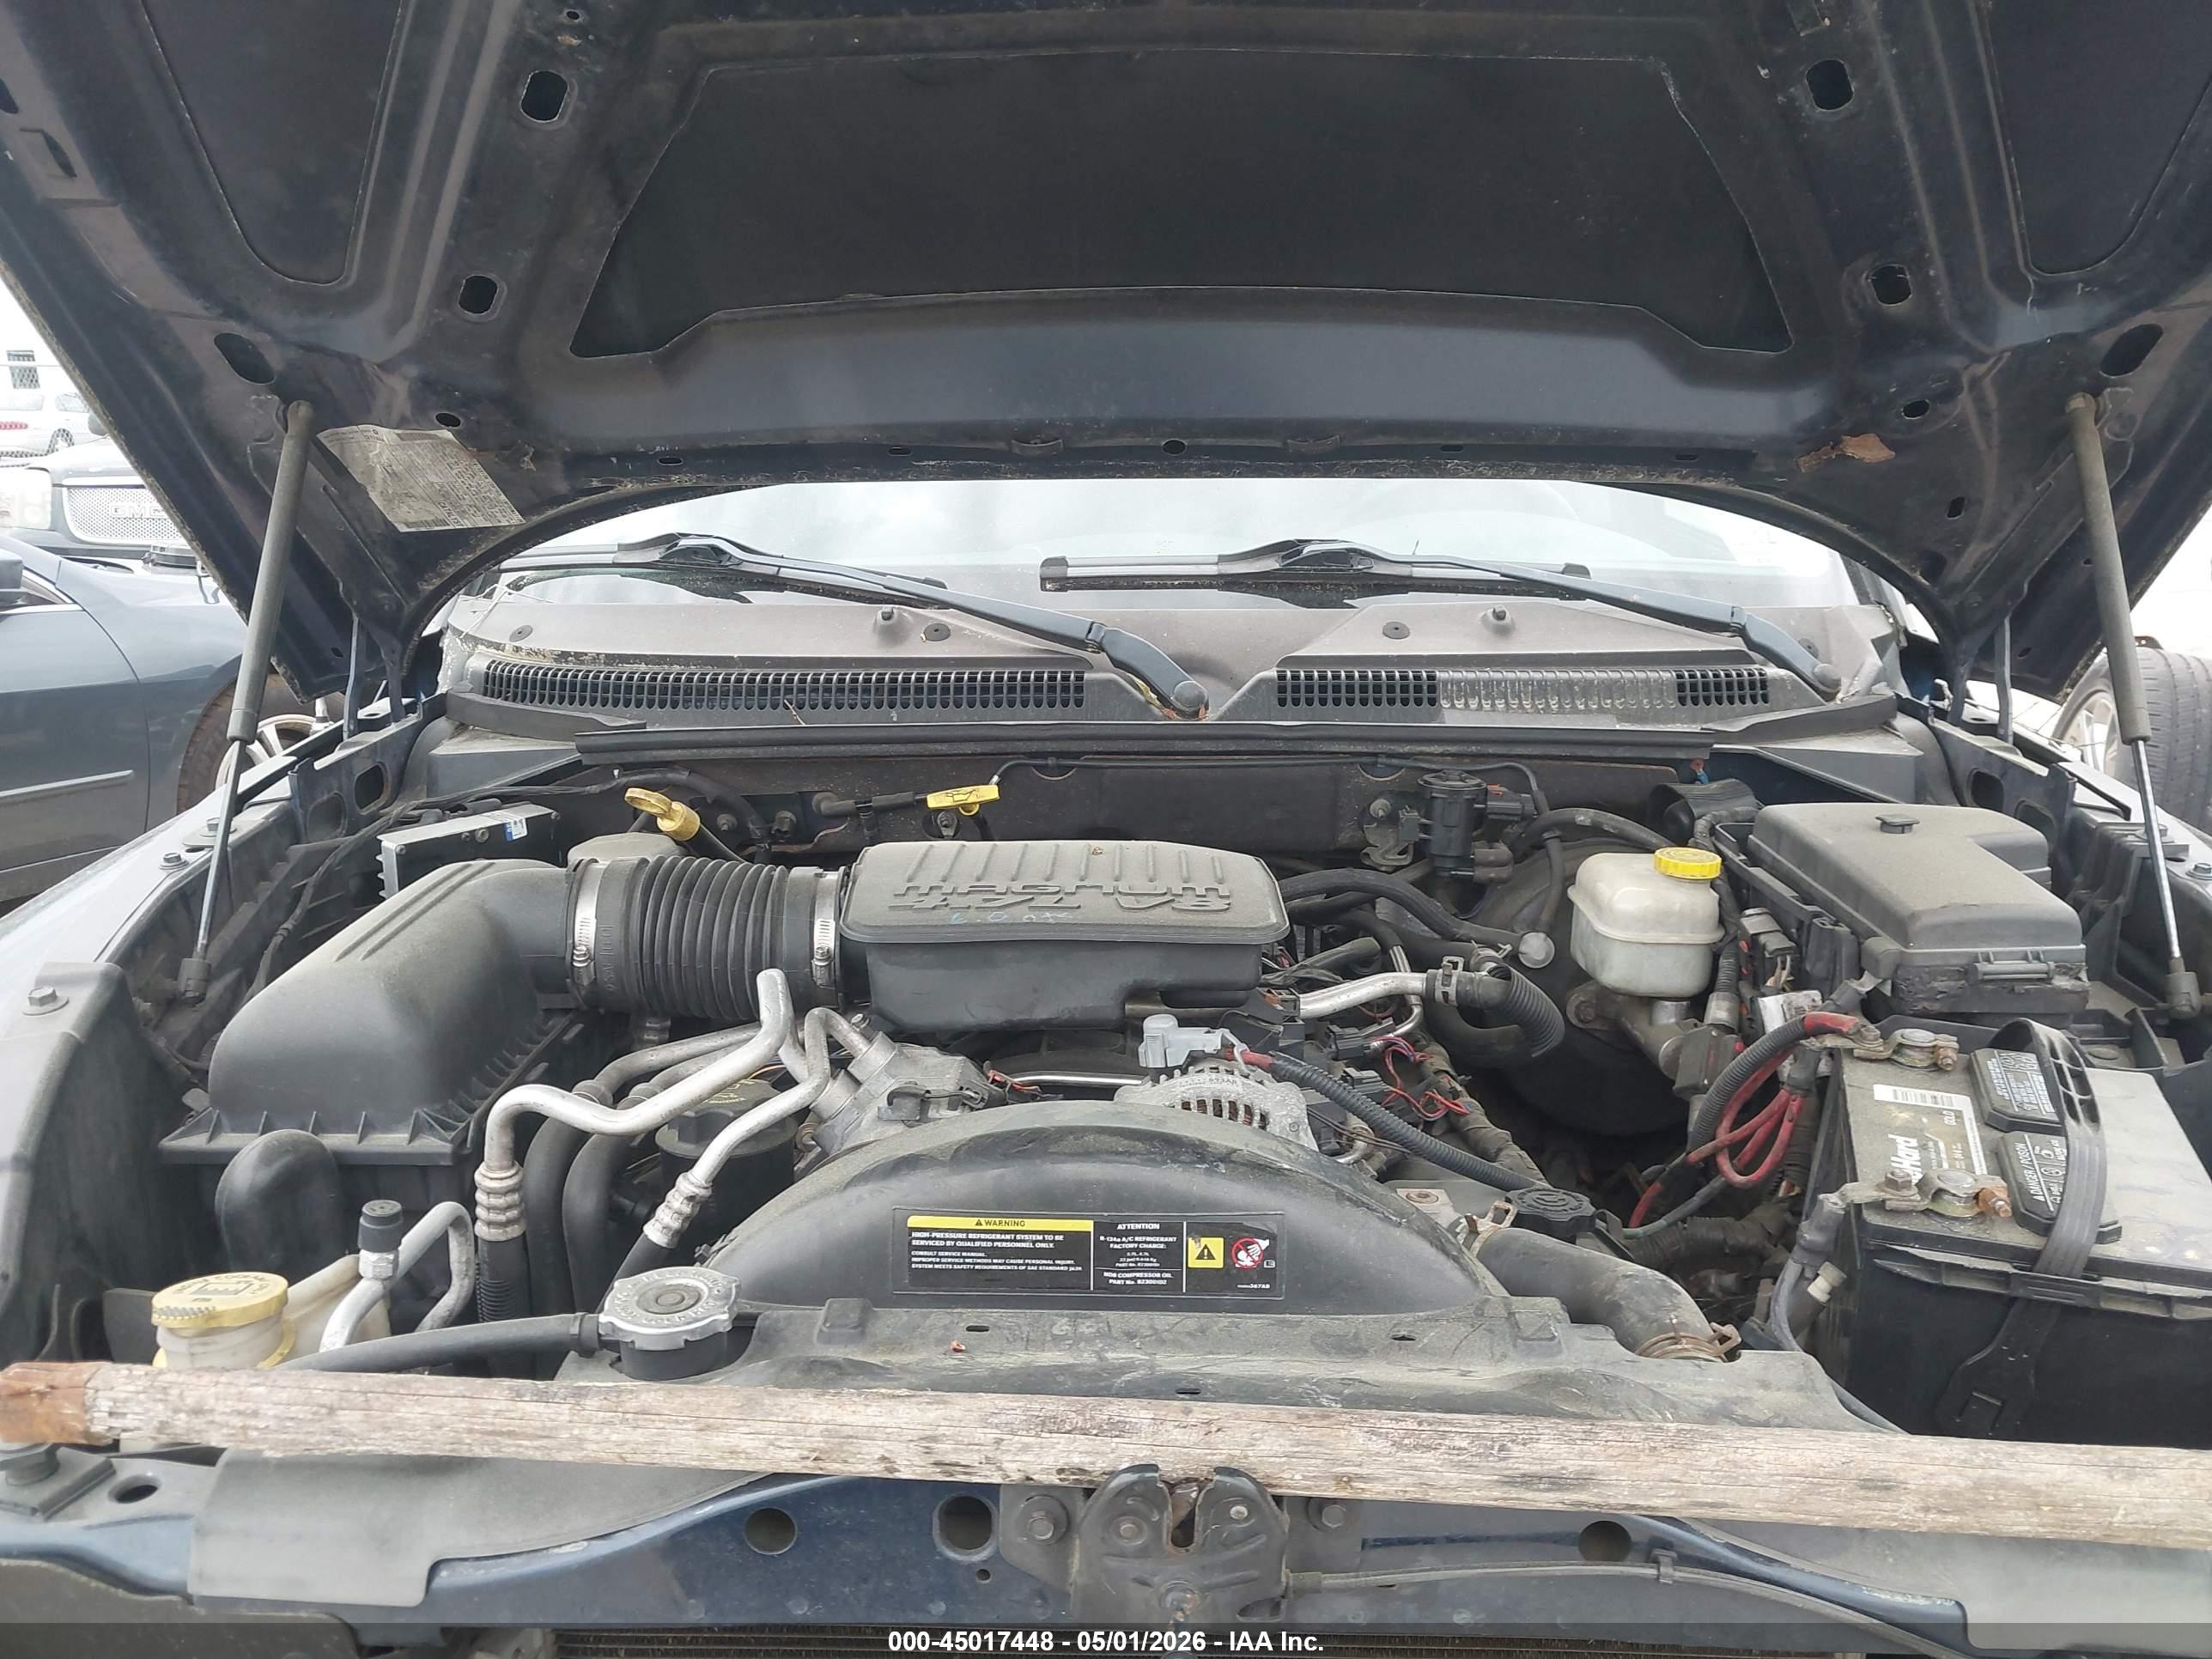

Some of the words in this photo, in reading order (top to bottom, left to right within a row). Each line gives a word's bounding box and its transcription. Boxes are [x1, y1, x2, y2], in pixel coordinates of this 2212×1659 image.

[437, 501, 465, 529] CATALYST
[893, 881, 1231, 897] MAGNUM
[1115, 896, 1231, 912] V8
[1942, 1110, 1957, 1126] GOLD
[2014, 1142, 2033, 1164] POISON
[2022, 1169, 2044, 1195] DANGER
[984, 1219, 1026, 1228] WARNING
